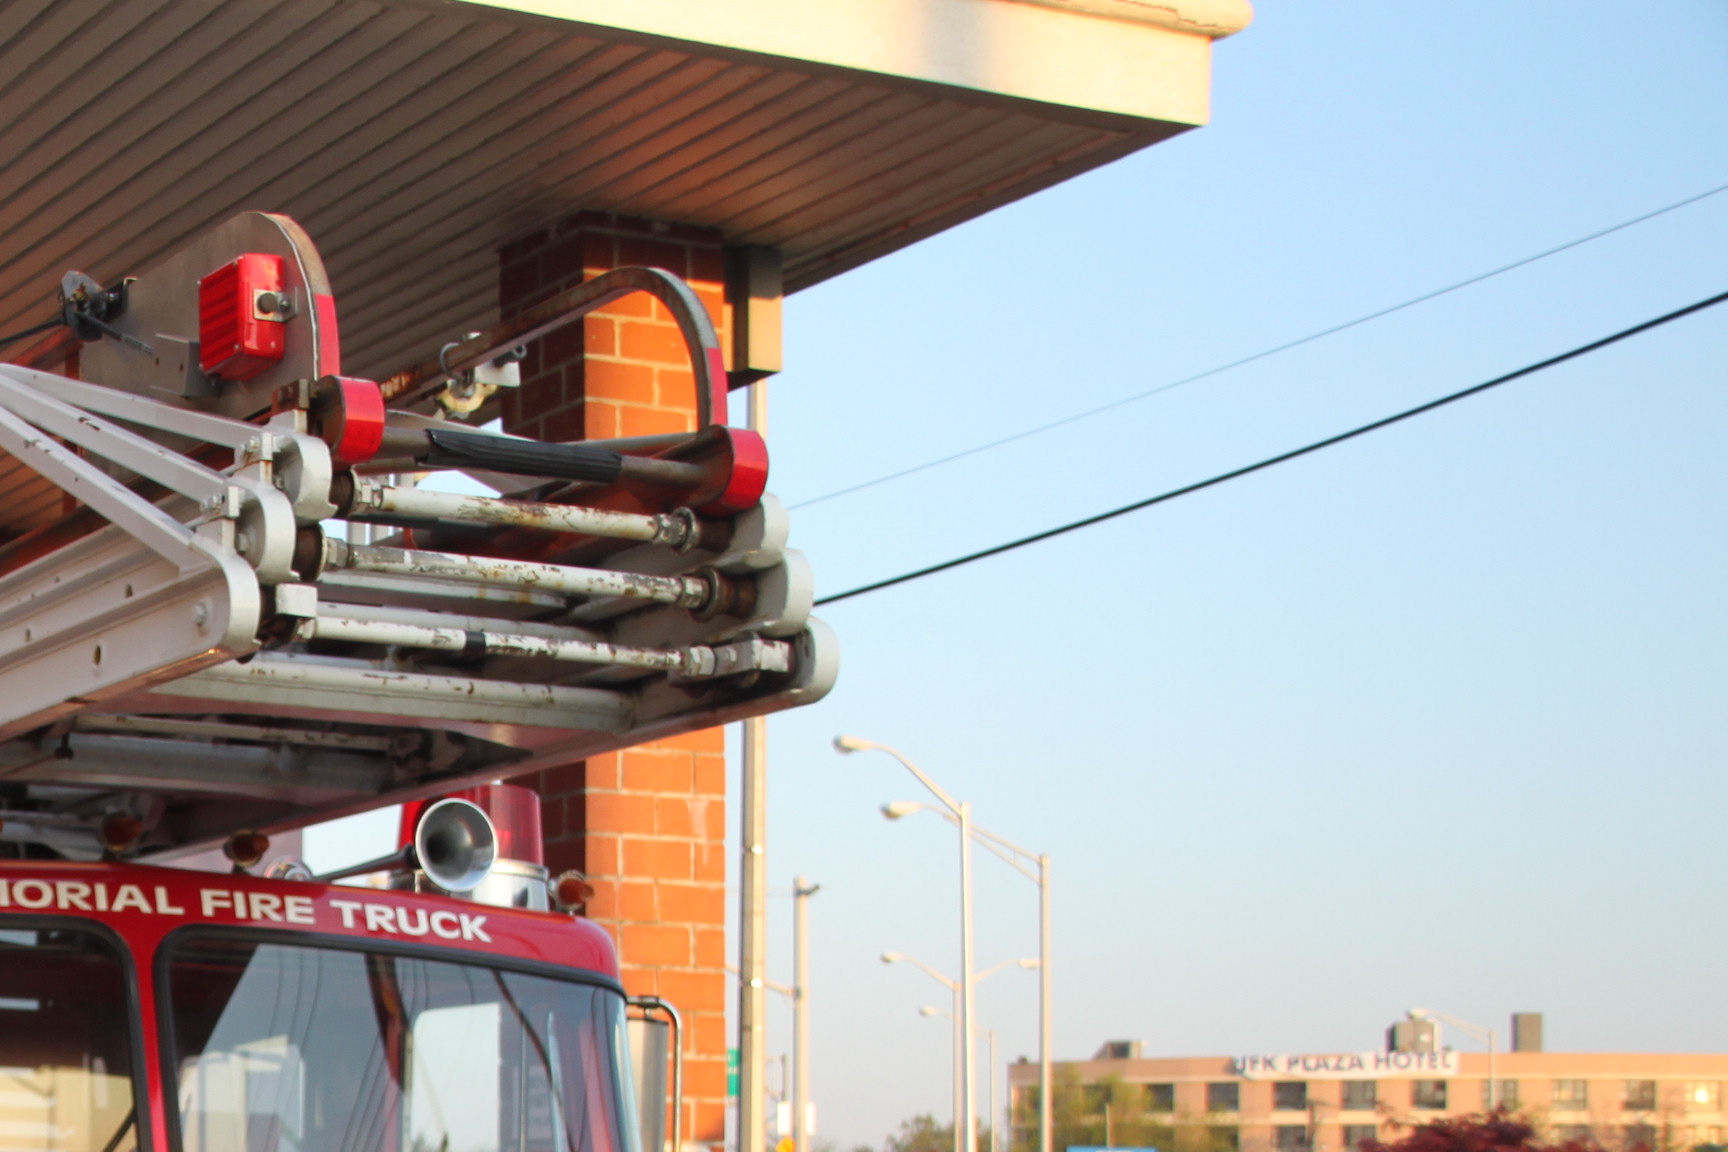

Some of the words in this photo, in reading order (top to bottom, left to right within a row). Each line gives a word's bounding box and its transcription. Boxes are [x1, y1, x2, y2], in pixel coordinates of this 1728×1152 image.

[200, 889, 316, 925] FIRE
[329, 899, 493, 944] TRUCK
[1235, 1055, 1275, 1074] JFK
[1286, 1055, 1364, 1072] PLAZA
[1374, 1052, 1451, 1070] HOTEL
